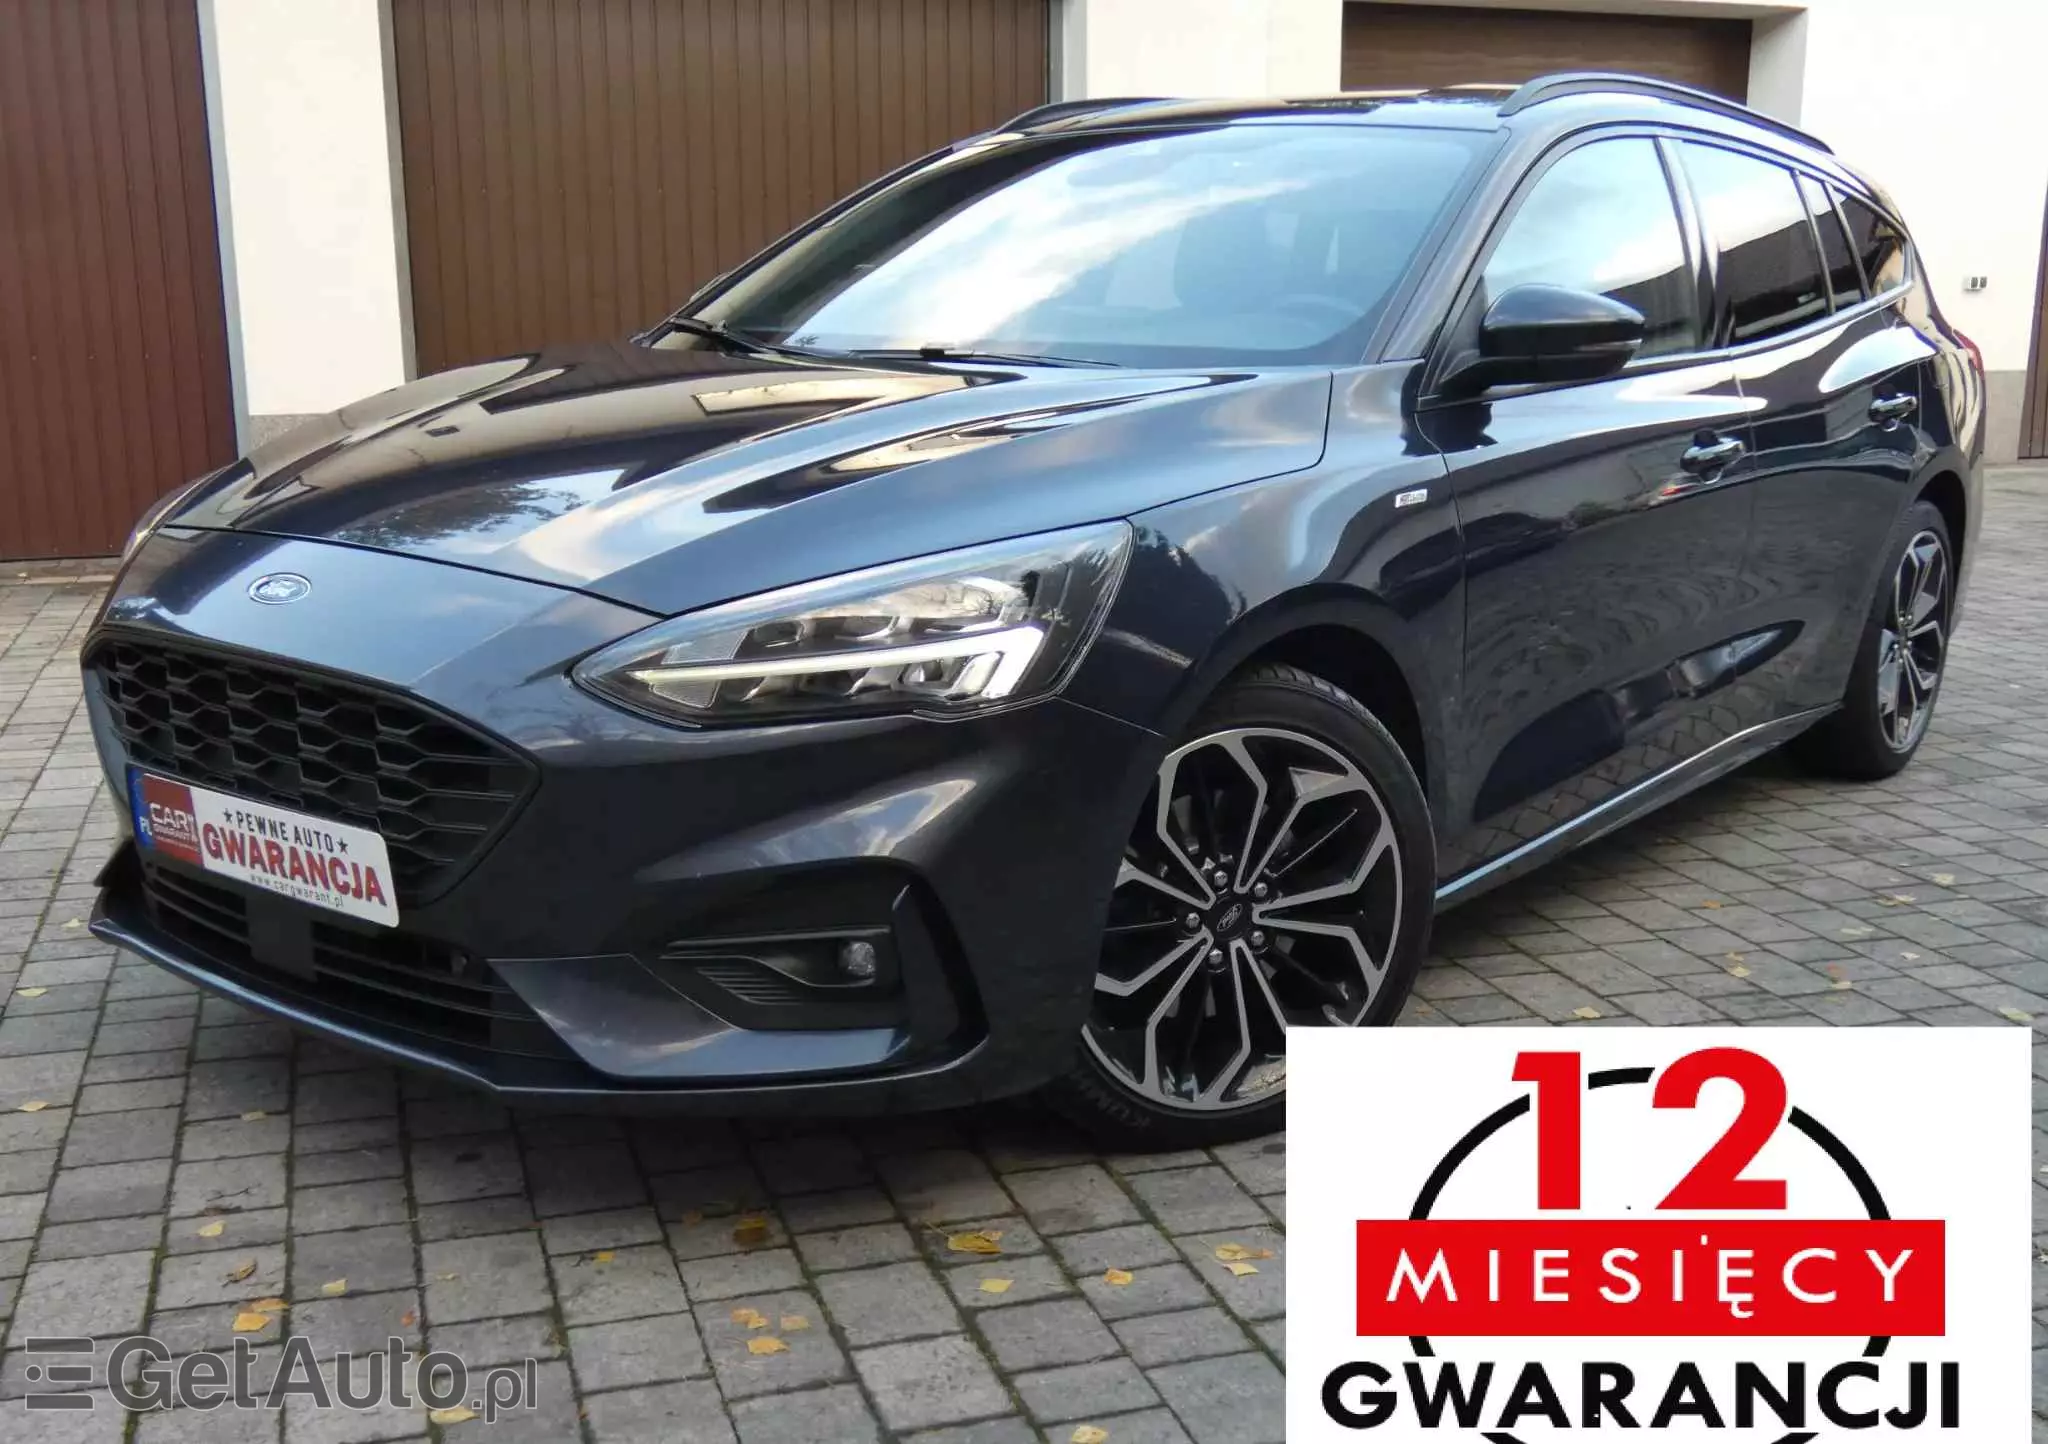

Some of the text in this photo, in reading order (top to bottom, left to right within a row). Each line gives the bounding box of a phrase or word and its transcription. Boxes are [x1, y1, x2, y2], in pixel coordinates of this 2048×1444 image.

[236, 811, 335, 852] PEWNE AUTO
[202, 822, 388, 907] GWARANCJA
